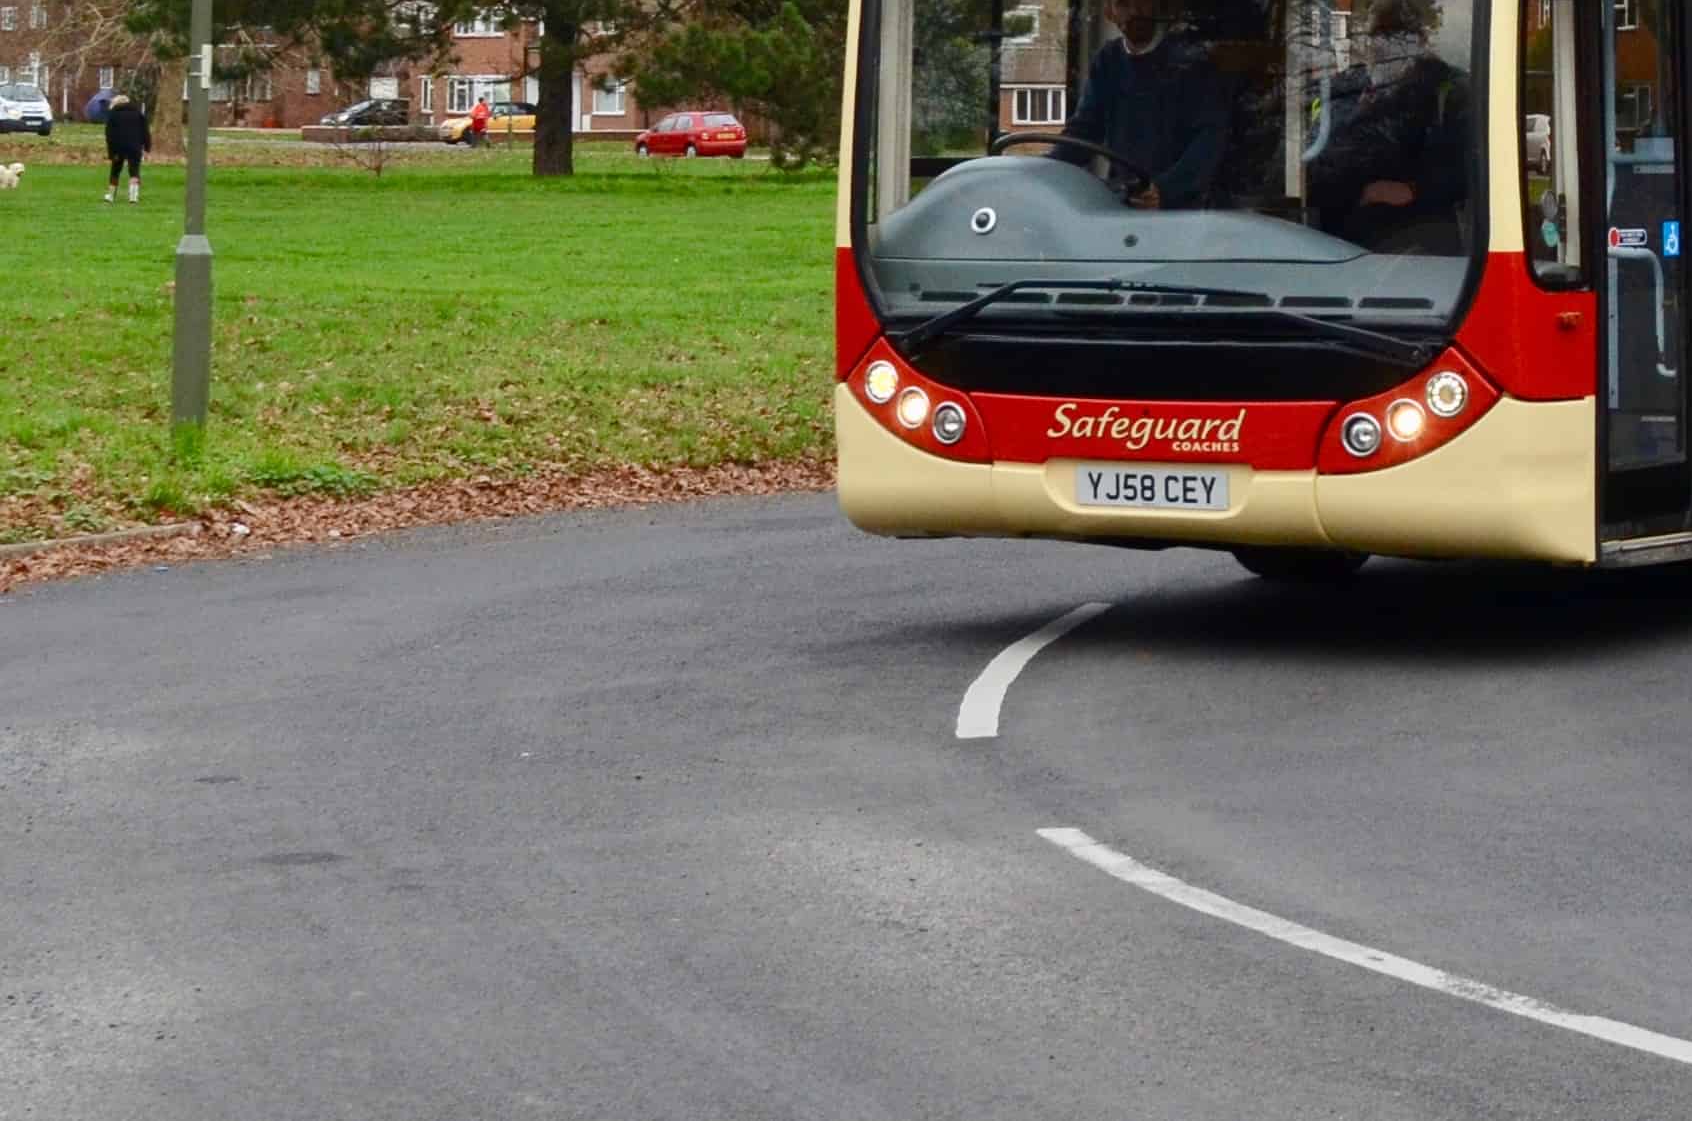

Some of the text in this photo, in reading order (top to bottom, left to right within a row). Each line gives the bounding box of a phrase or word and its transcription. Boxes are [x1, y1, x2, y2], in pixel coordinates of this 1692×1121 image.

[1046, 402, 1246, 450] Safeguard
[1171, 440, 1240, 453] COACHES
[1088, 470, 1216, 504] YJ58 CEY
